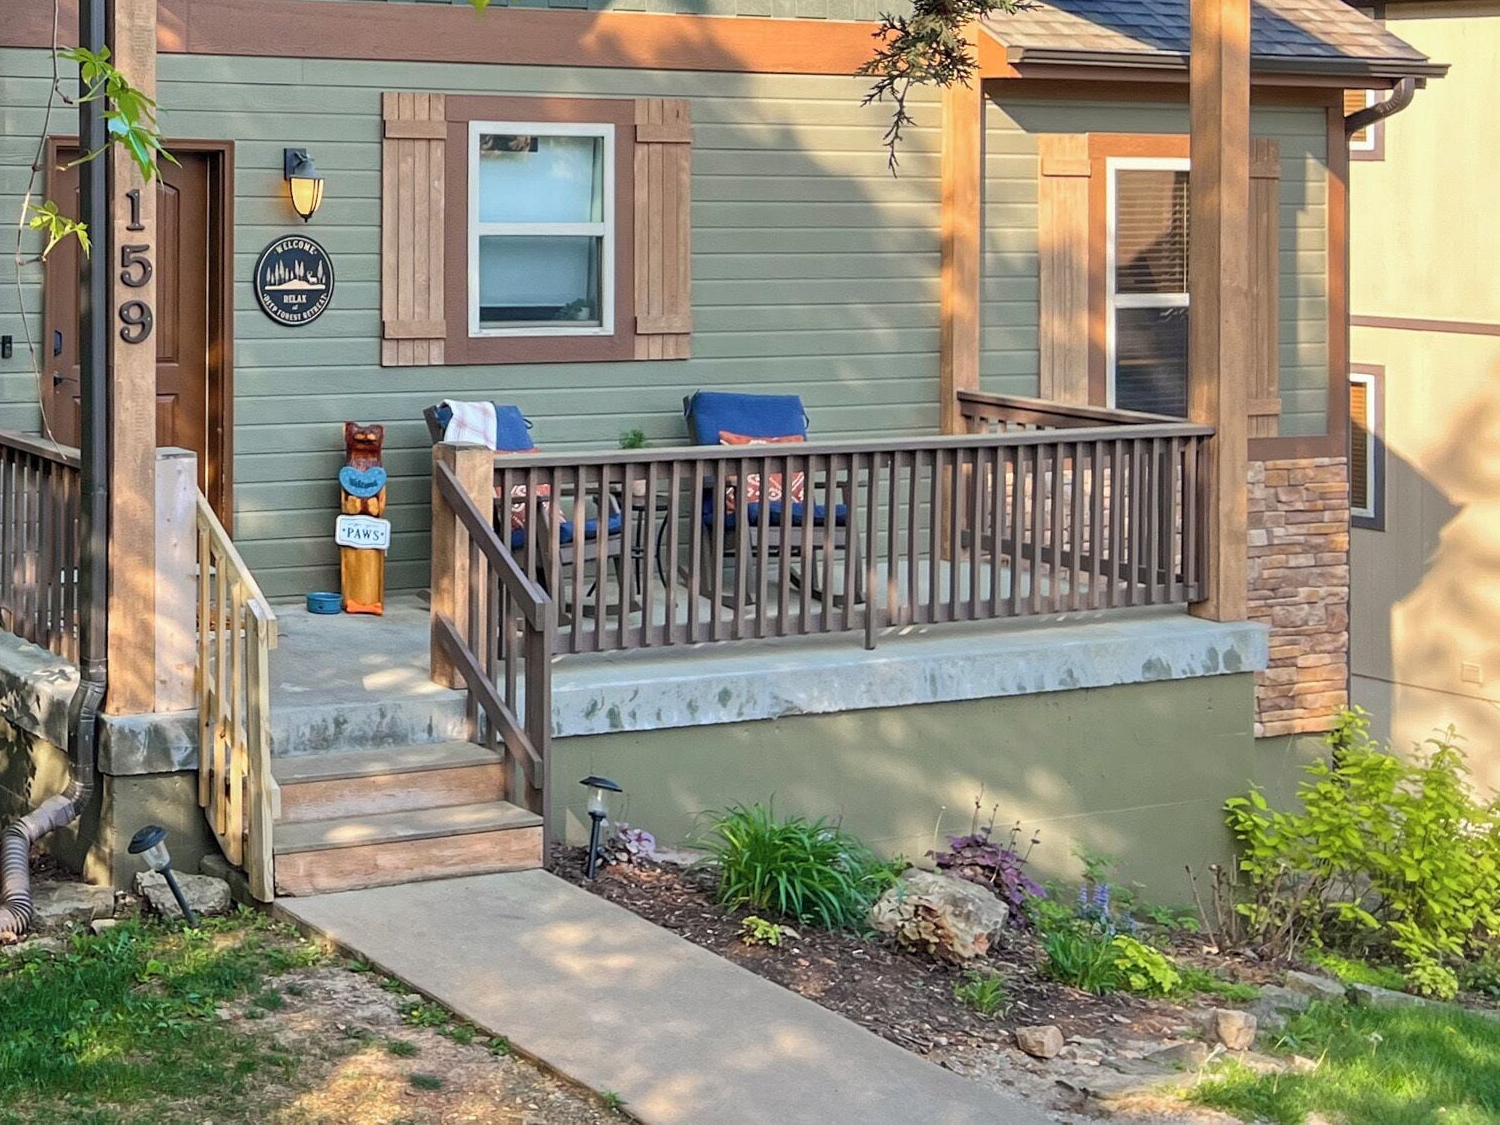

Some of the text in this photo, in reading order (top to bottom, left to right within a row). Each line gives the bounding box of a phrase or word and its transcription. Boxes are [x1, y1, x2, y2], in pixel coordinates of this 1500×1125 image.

[275, 240, 316, 255] WELCOME
[119, 188, 153, 344] 159
[283, 294, 307, 303] RELAX
[276, 309, 302, 321] FOREST
[347, 527, 379, 541] PAWS
